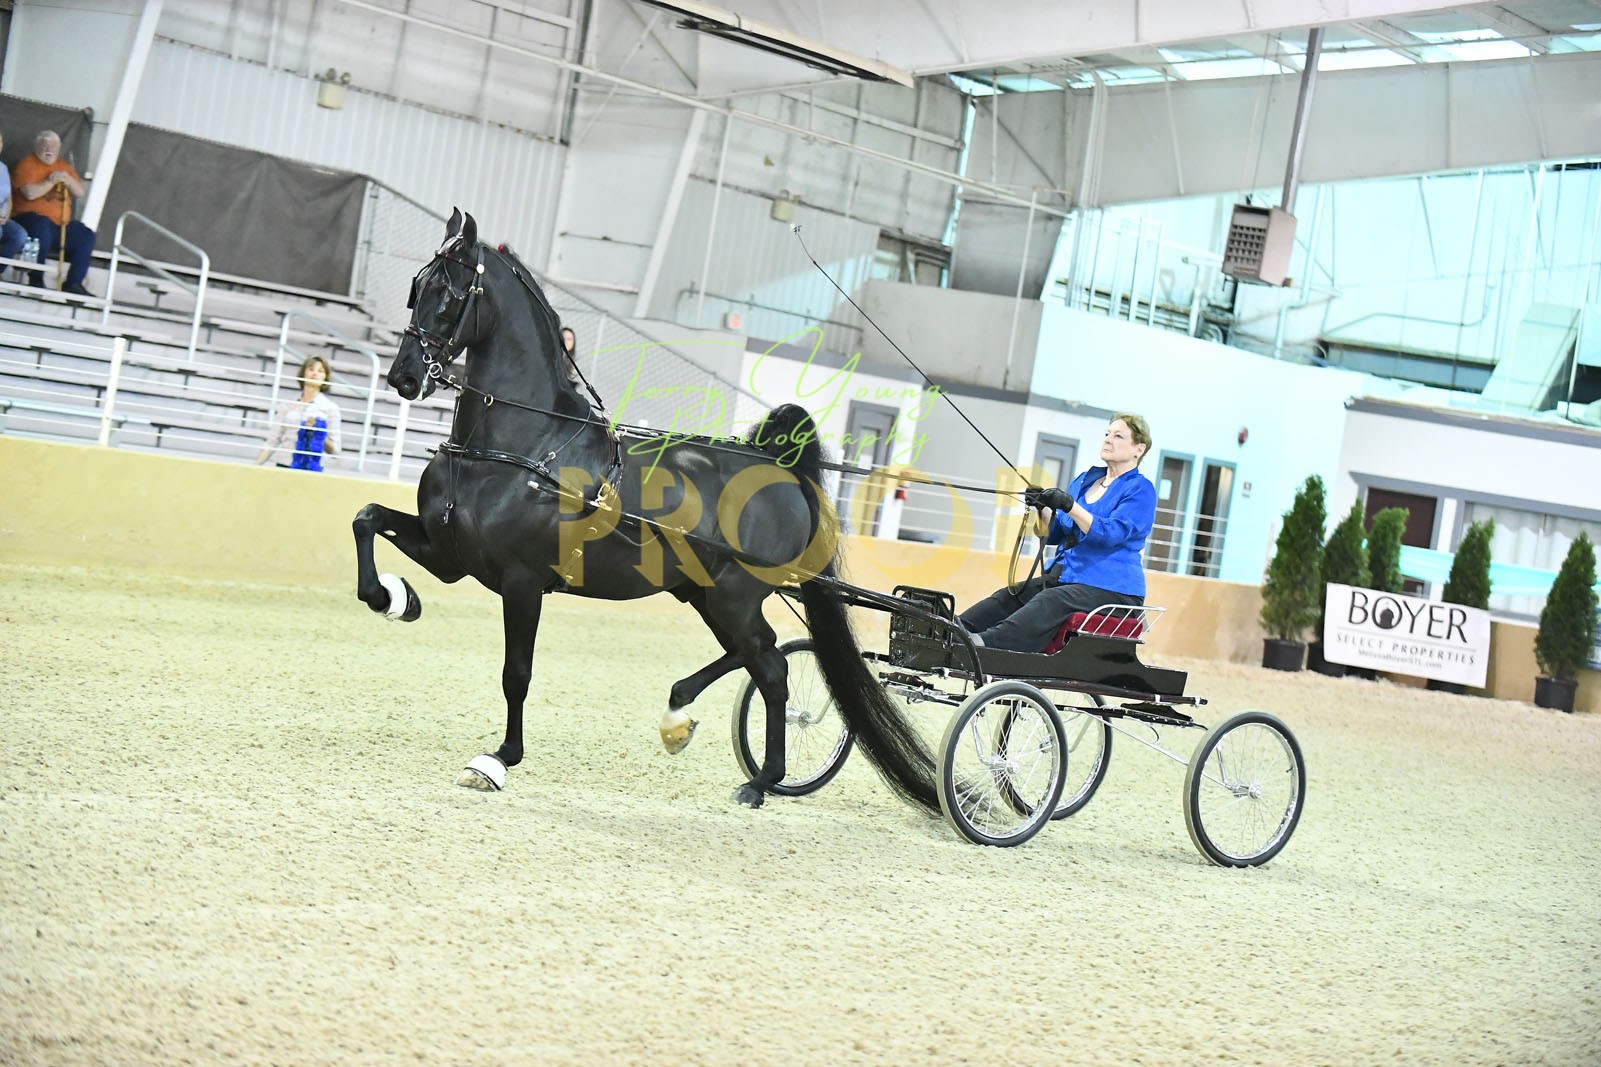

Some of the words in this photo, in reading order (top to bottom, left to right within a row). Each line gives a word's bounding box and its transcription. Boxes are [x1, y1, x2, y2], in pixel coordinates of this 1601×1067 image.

[1348, 591, 1468, 643] BOYER
[1337, 633, 1384, 648] SELECT
[1392, 642, 1476, 665] PROPERTIES
